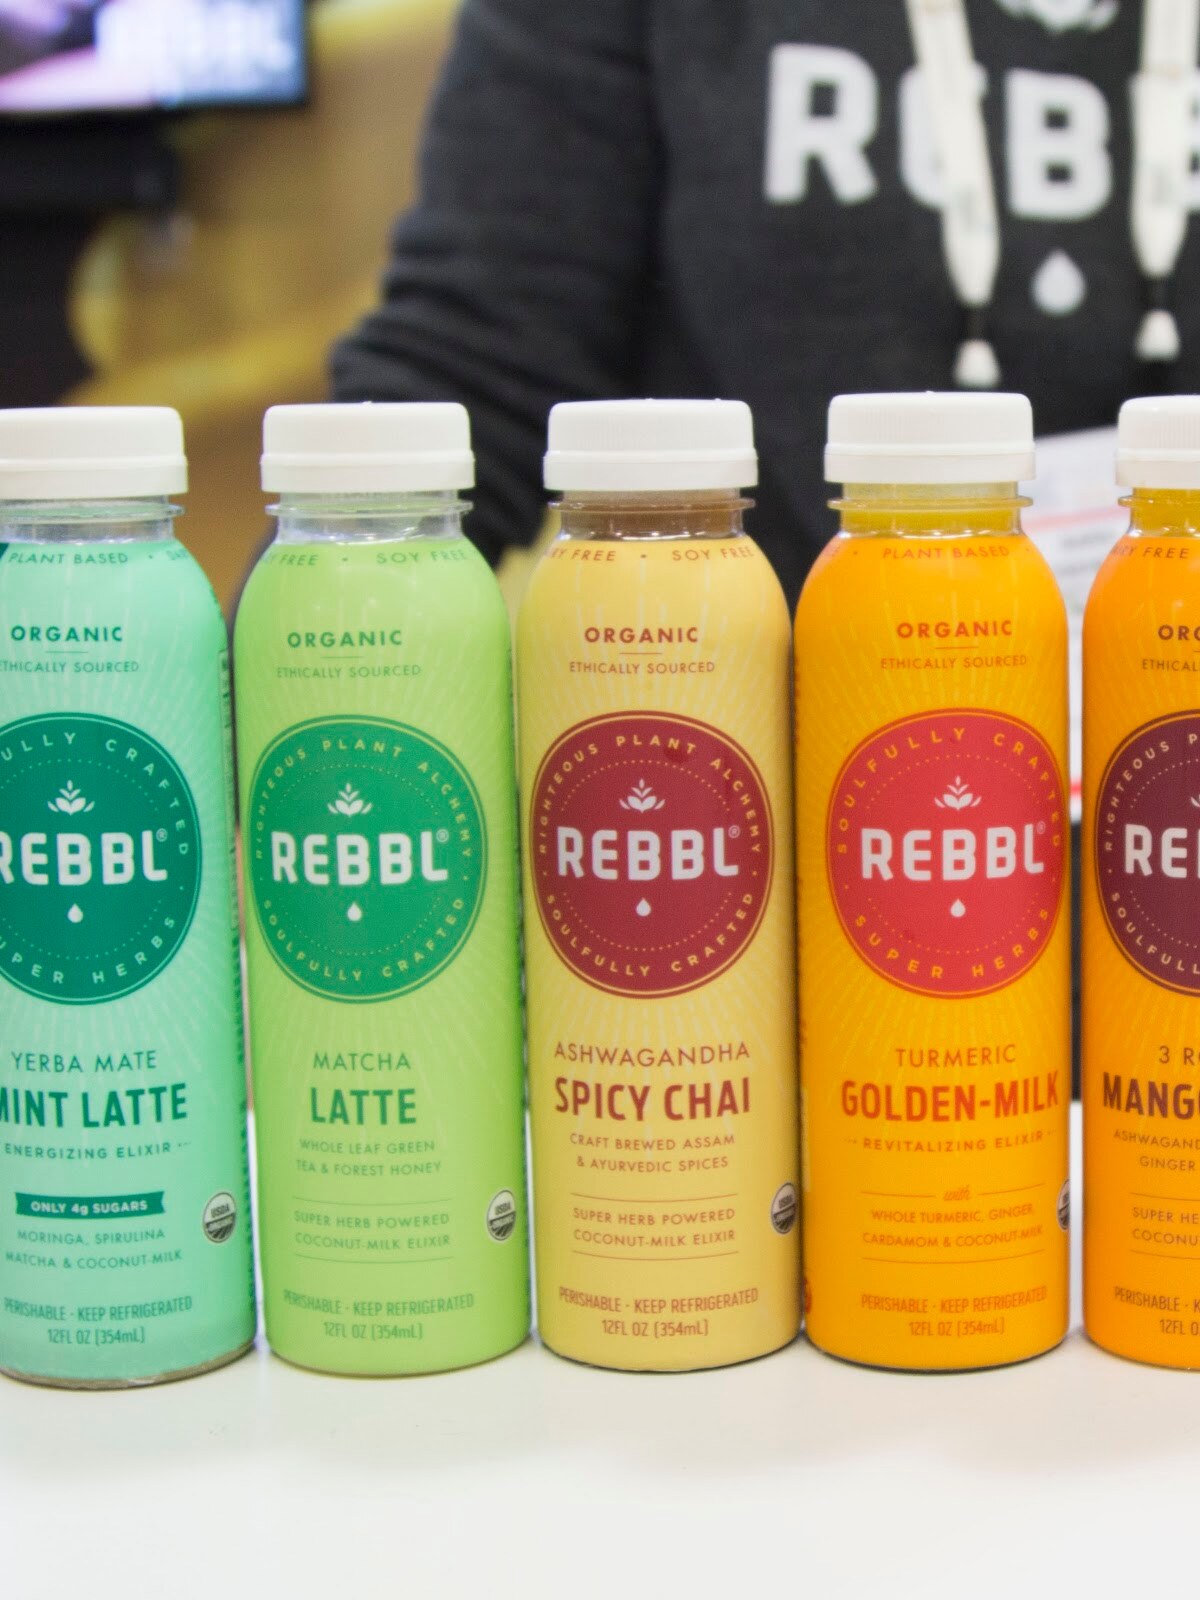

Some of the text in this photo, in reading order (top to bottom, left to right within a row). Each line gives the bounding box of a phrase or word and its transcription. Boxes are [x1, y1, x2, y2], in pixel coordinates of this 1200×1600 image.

[9, 553, 128, 564] PLANT BASED
[572, 547, 754, 561] FREE SOY FREE
[11, 626, 123, 642] ORGANIC
[585, 627, 698, 643] ORGANIC
[897, 620, 1012, 638] ORGANIC
[288, 630, 402, 648] ORGANIC
[278, 665, 421, 678] ETHICALLY SOURCED
[570, 661, 714, 674] ETHICALLY SOURCED
[323, 739, 402, 757] PLANT
[105, 739, 189, 855] CRAFTED
[539, 735, 760, 854] RIGHTEOUS PLANT ALCHEMY
[838, 728, 965, 854] SOULFULLY
[1105, 741, 1169, 851] RIGHTEOUS
[271, 831, 448, 885] REBBL
[557, 826, 739, 880] REBBL
[861, 824, 1044, 881] REBBL
[547, 893, 752, 976] SOULFULLY CRAFTED
[92, 917, 175, 983] HERBS
[856, 909, 1048, 979] SUPER HERBS
[11, 1051, 157, 1072] YERBA MATE
[313, 1052, 411, 1071] MATCHA
[554, 1041, 750, 1067] ASHWAGANDHA
[896, 1044, 1016, 1068] TURMERIC
[1160, 1046, 1170, 1064] 3
[81, 1083, 188, 1128] LATTE
[311, 1087, 416, 1124] LATTE
[555, 1077, 749, 1122] SPICY CHAI
[841, 1071, 1059, 1122] GOLDEN-MILK
[300, 1139, 434, 1154] WHOLE LEAF GREEN
[570, 1132, 735, 1150] CRAFT BREWED ASSAM
[864, 1130, 1042, 1152] REVITALIZING ELIXIR
[5, 1143, 171, 1160] ENERGIZING ELIXIR
[296, 1160, 440, 1176] TEA & FOREST HONEY
[577, 1156, 728, 1172] & AYURVEDIC SPICES
[1140, 1156, 1195, 1171] GINGER
[31, 1200, 147, 1215] ONLY 4g SUGARS
[1132, 1206, 1173, 1222] SUPER
[17, 1229, 165, 1245] MORINGA, SPIRULINA
[6, 1253, 55, 1267] MATCHA
[63, 1259, 71, 1268] &
[559, 1286, 758, 1314] PERISHABLE KEEP REFRIGERATED
[602, 1319, 648, 1336] 12FL OZ
